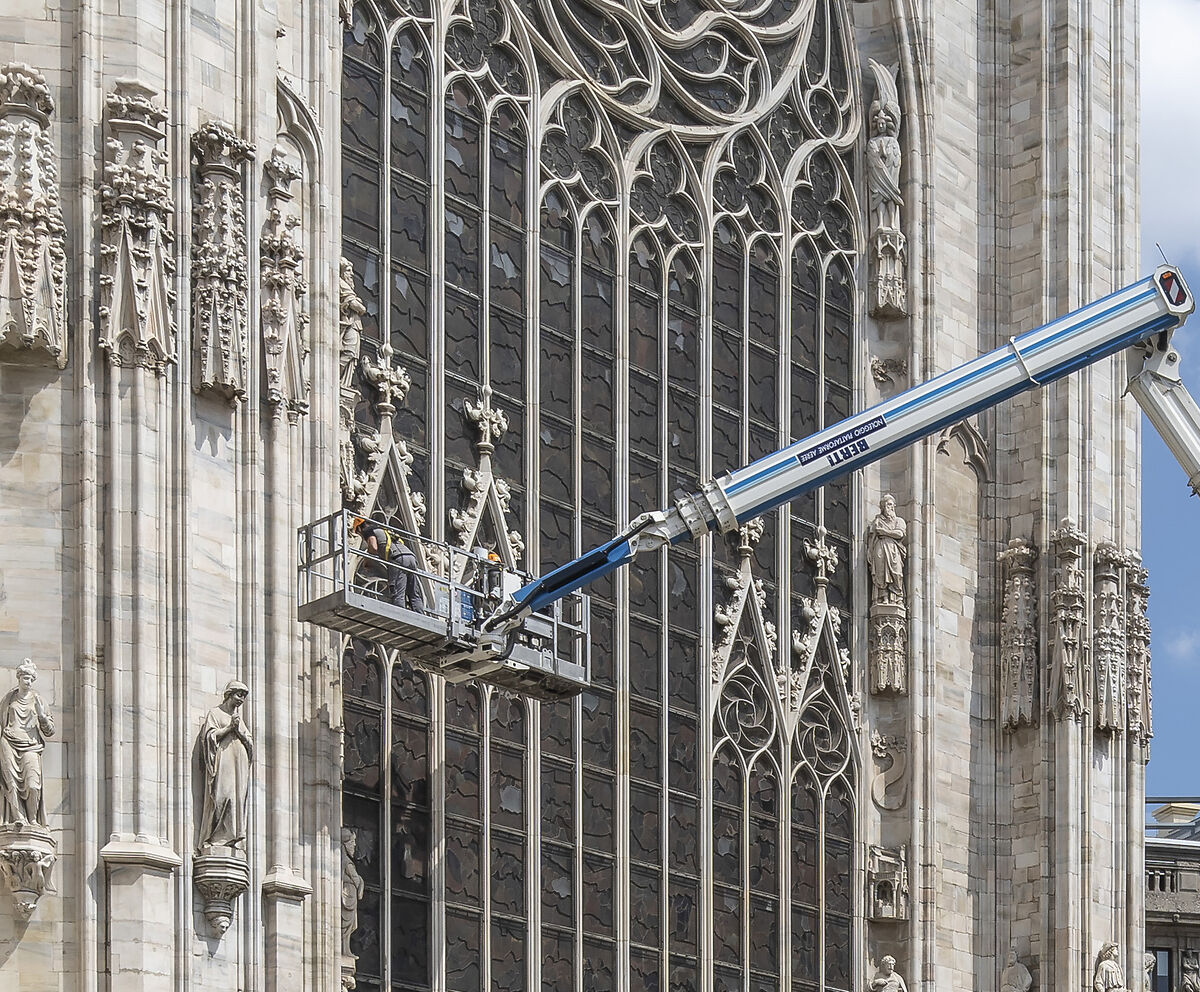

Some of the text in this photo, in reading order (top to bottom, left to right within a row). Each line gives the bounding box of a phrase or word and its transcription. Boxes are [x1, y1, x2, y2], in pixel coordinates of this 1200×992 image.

[800, 418, 884, 462] NOLEGGIO PIATTAFORME AEREE
[826, 439, 870, 467] BERTI
